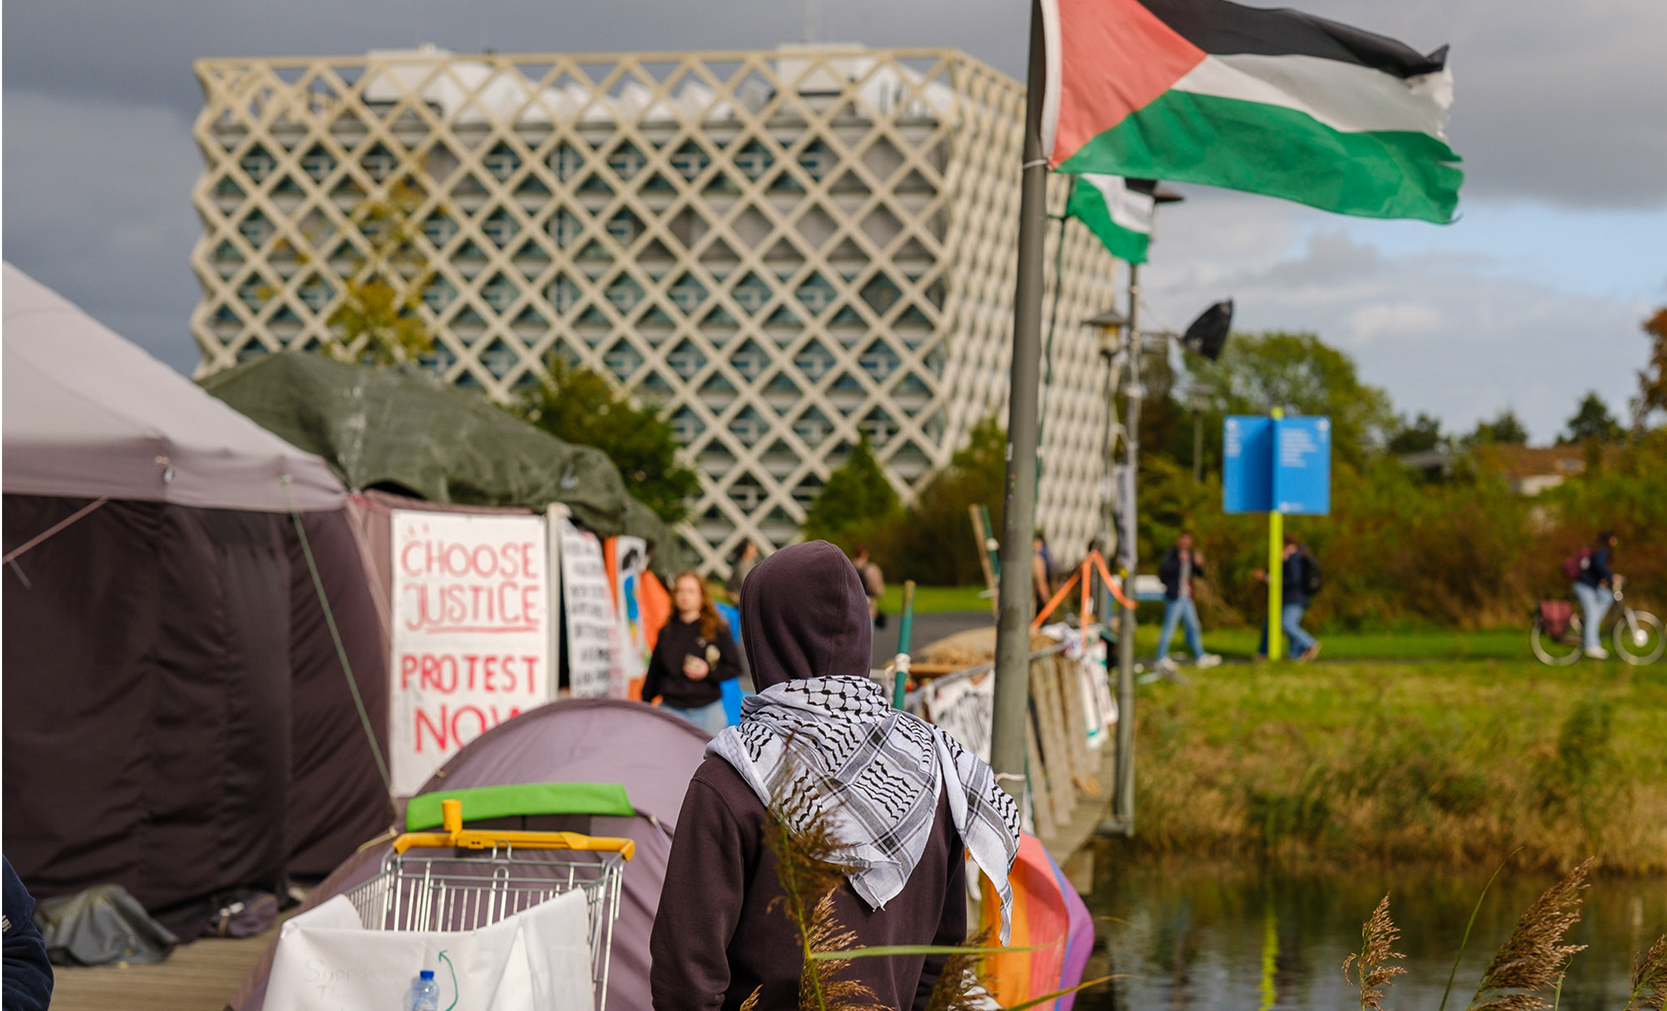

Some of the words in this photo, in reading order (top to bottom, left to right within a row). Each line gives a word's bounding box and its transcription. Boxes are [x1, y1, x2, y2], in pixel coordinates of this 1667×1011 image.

[401, 541, 538, 578] CHOOSE
[403, 581, 540, 629] JUSTICE
[401, 654, 539, 694] PROTEST
